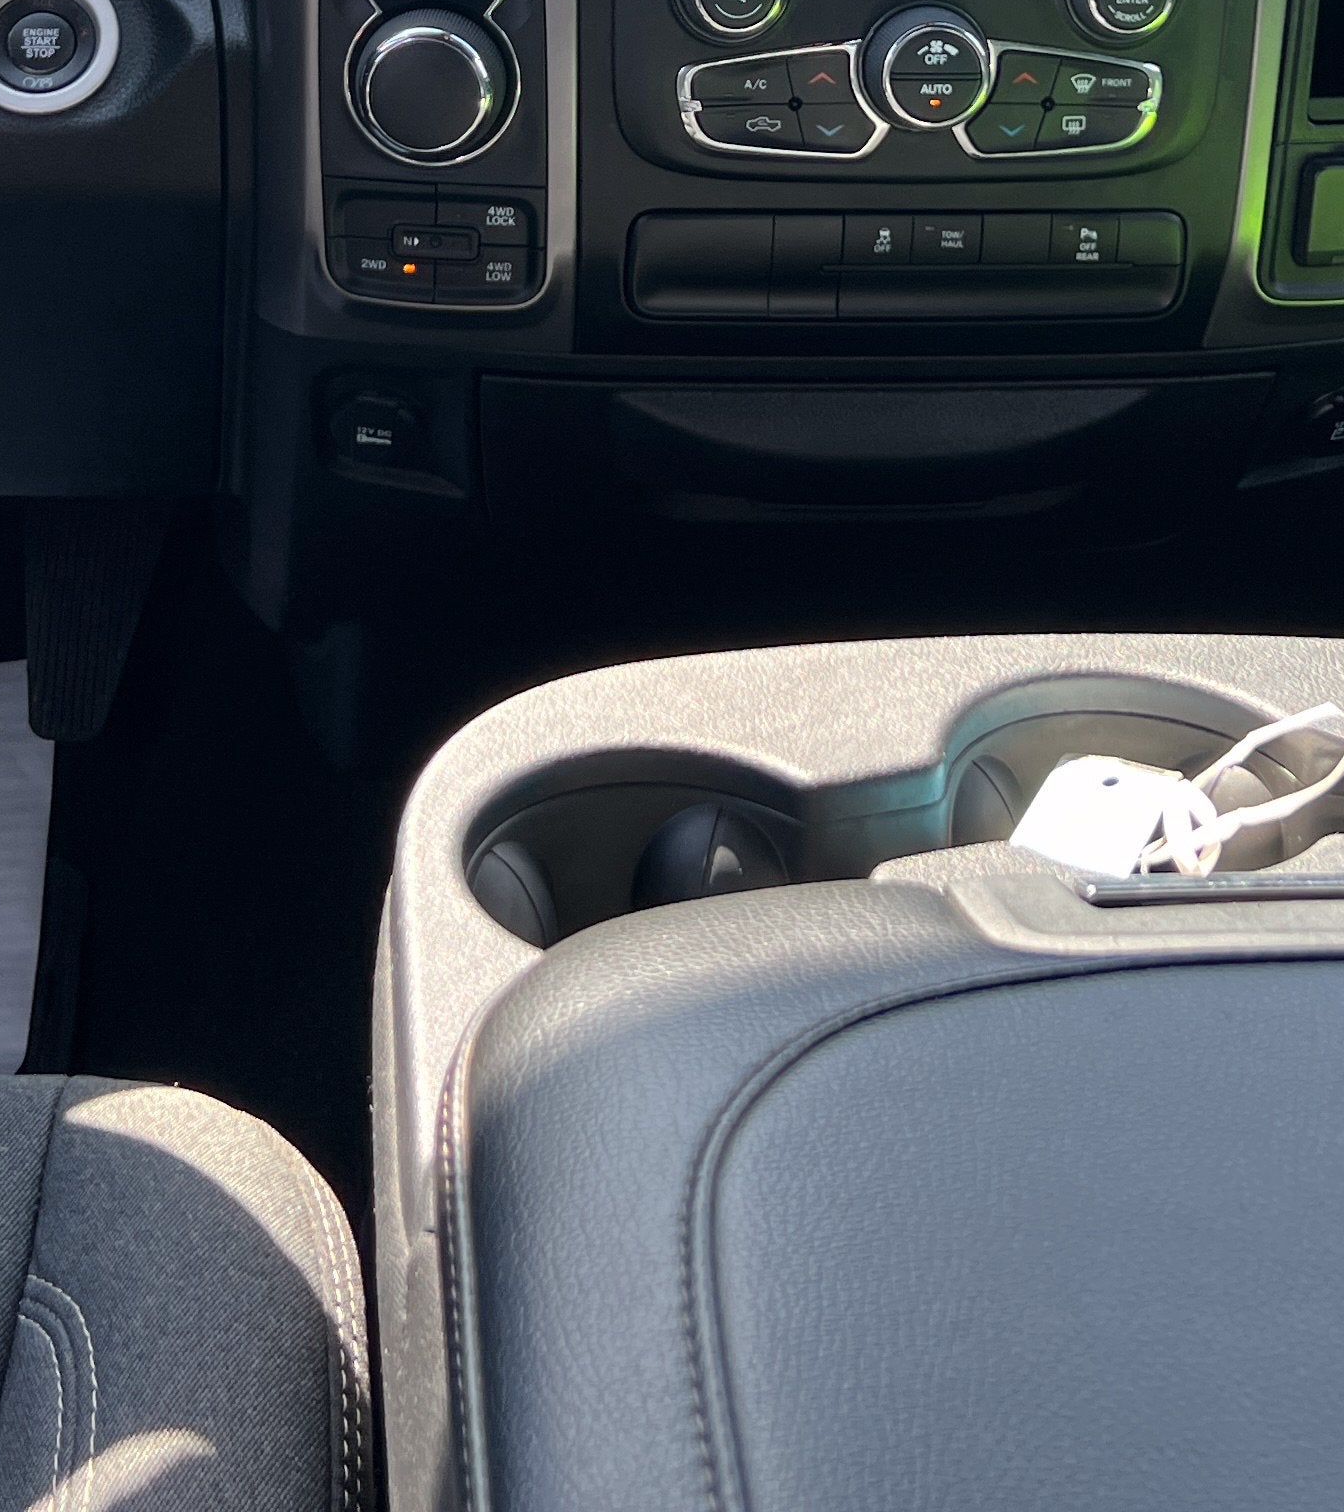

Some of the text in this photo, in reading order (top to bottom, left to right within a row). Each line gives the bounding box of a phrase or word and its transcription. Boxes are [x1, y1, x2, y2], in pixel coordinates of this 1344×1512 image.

[1114, 10, 1147, 23] SCROLL
[23, 28, 60, 37] ENGINE
[24, 37, 58, 46] START
[26, 48, 56, 58] STOP
[924, 54, 947, 66] OFF
[744, 78, 767, 90] A/C
[1101, 77, 1132, 88] FRONT
[920, 83, 953, 95] AUTO
[487, 206, 515, 217] 4WD
[486, 215, 516, 226] LOCK
[873, 243, 892, 253] OFF
[1079, 242, 1096, 252] OFF
[1075, 251, 1100, 261] REAR
[361, 258, 387, 270] 2WD
[486, 262, 512, 272] 4WD
[485, 271, 512, 281] LOW
